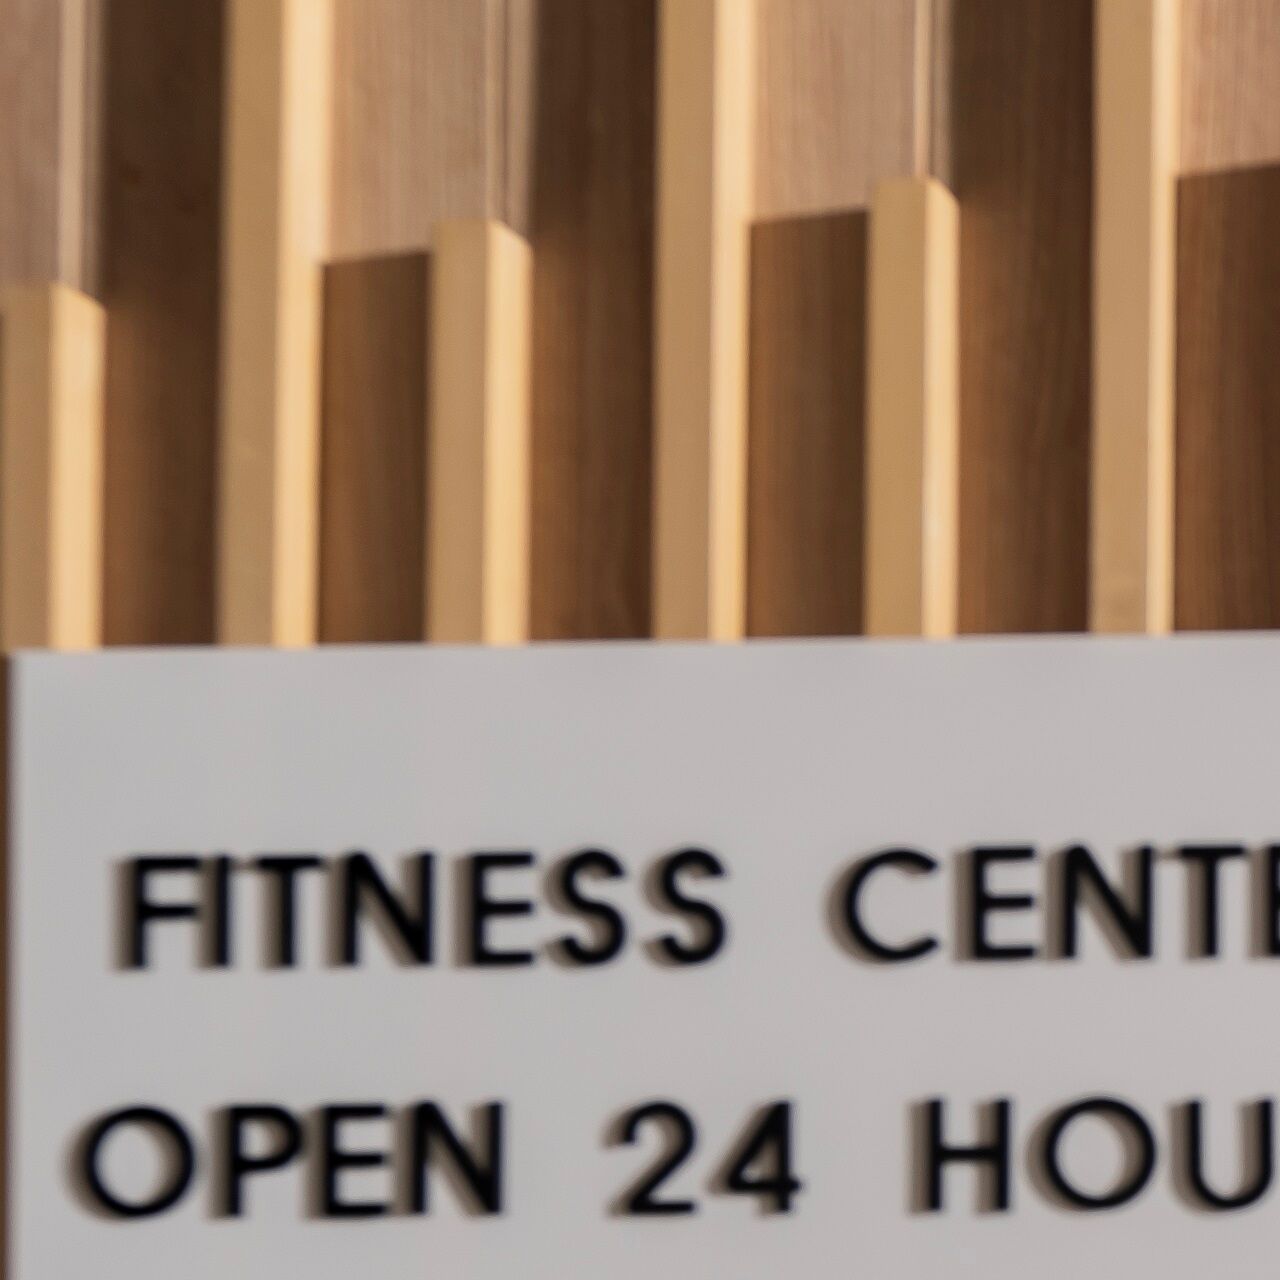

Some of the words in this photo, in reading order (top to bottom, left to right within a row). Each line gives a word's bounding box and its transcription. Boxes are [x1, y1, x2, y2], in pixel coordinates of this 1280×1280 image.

[122, 848, 728, 970] FITNESS
[70, 1099, 505, 1222] OPEN
[605, 1098, 802, 1217] 24
